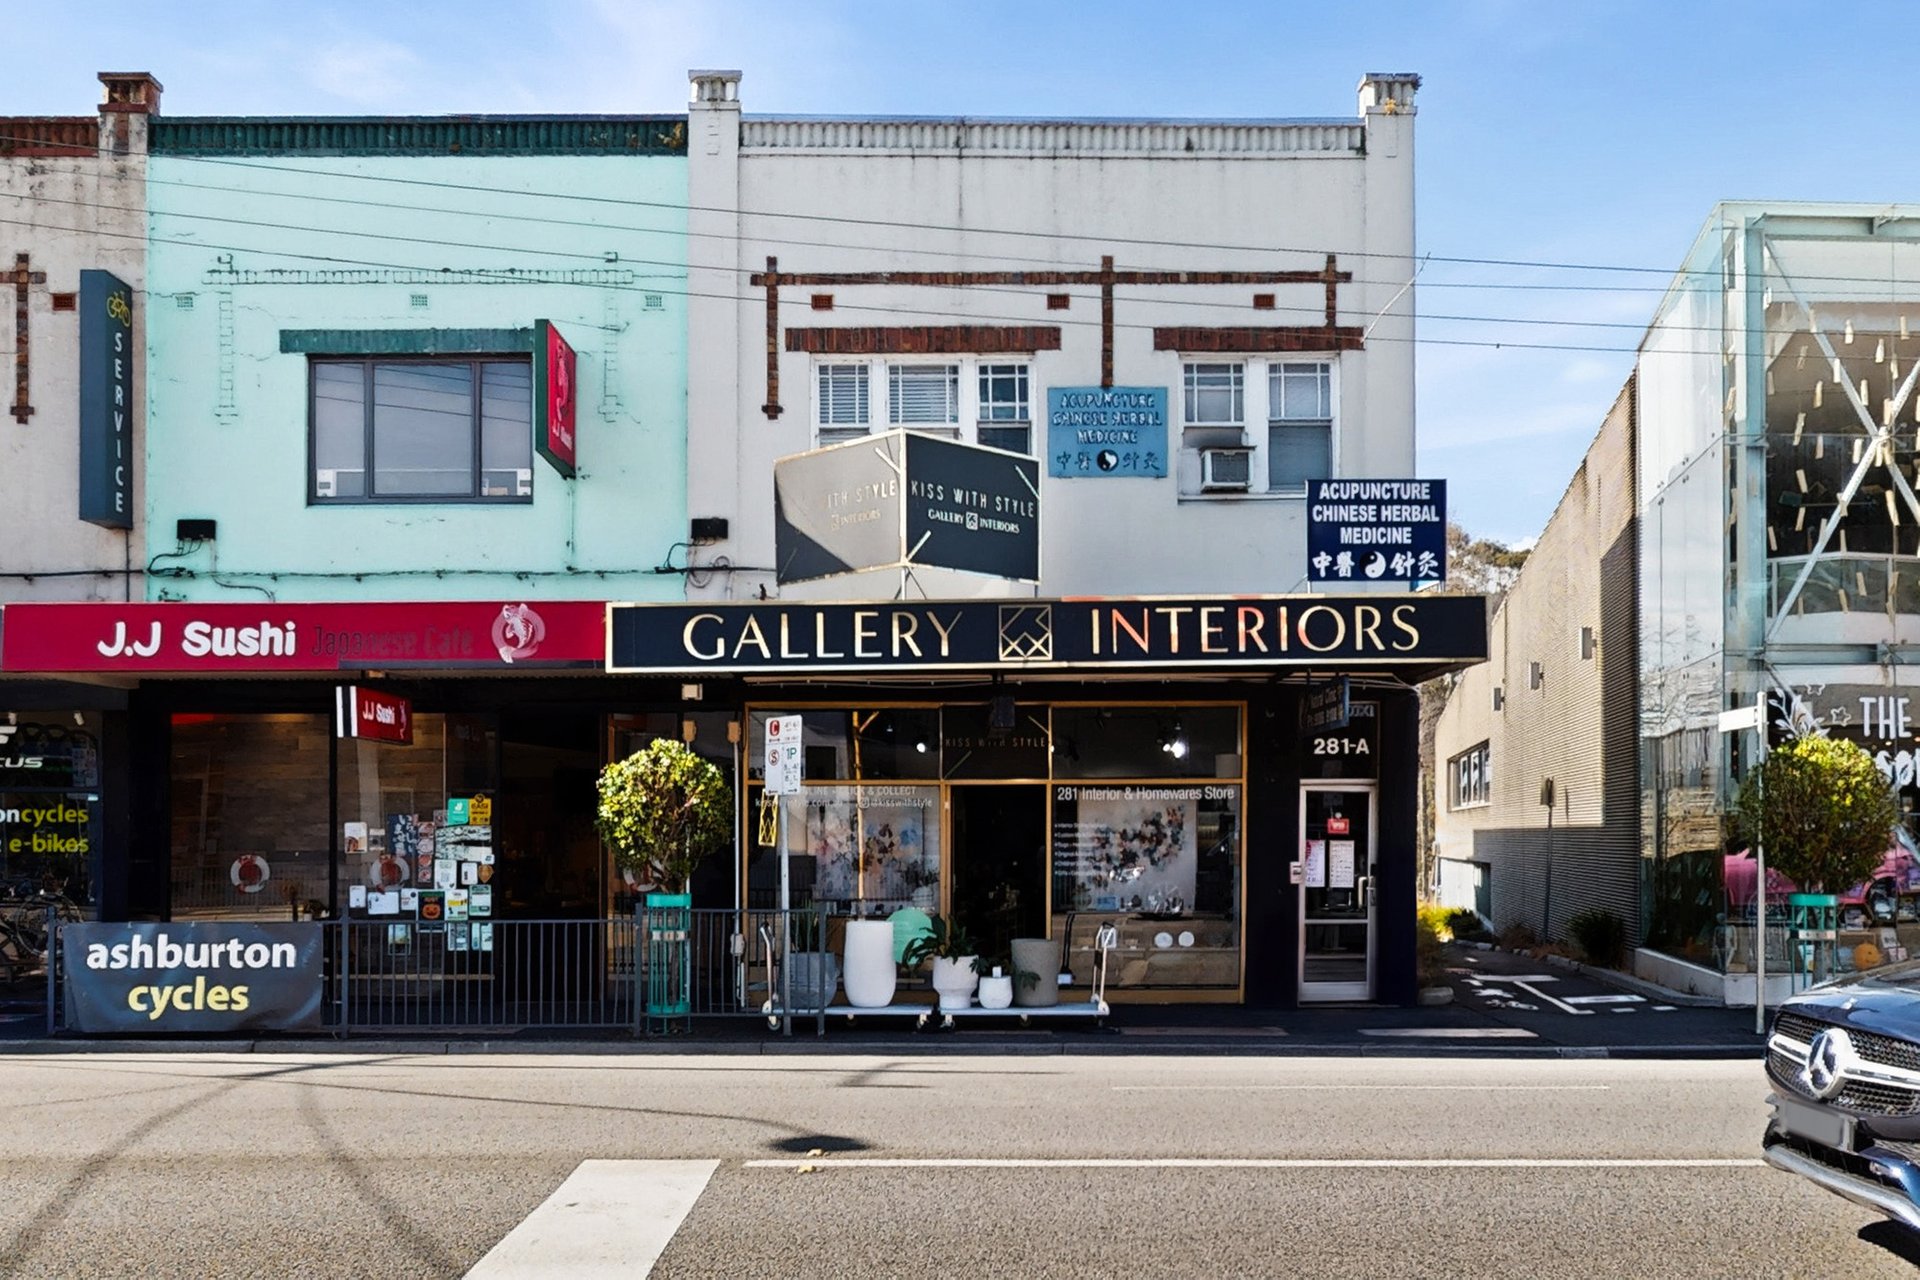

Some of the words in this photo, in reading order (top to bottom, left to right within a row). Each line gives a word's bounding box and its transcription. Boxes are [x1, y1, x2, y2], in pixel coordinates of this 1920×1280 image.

[114, 332, 125, 513] SERVICE
[1076, 429, 1138, 445] MEDICINE
[827, 490, 848, 507] ITH
[855, 479, 897, 505] STYLE
[911, 479, 944, 500] KISS
[953, 487, 987, 509] WITH
[995, 497, 1035, 519] STYLE
[1319, 482, 1431, 500] ACUPUNCTURE
[928, 508, 964, 524] GALLERY
[979, 517, 1020, 534] INTERIORS
[1312, 504, 1377, 522] CHINESE
[1381, 504, 1440, 522] HERBAL
[1340, 527, 1412, 544] MEDICINE
[97, 620, 162, 657] J.J
[181, 620, 296, 657] Sushi
[311, 625, 417, 657] Japanese
[682, 611, 963, 660] GALLERY
[1091, 605, 1421, 655] INTERIORS
[1858, 695, 1912, 740] THE
[1313, 737, 1370, 755] 281-A
[0, 757, 43, 768] US
[876, 785, 917, 796] COLLECT
[1057, 786, 1078, 801] 281
[1081, 786, 1122, 801] Interior
[1124, 786, 1134, 800] &
[1136, 786, 1203, 800] Homewares
[1204, 785, 1235, 800] Store
[9, 833, 90, 853] e-bikes
[86, 933, 297, 969] ashburton
[128, 976, 250, 1020] cycles
